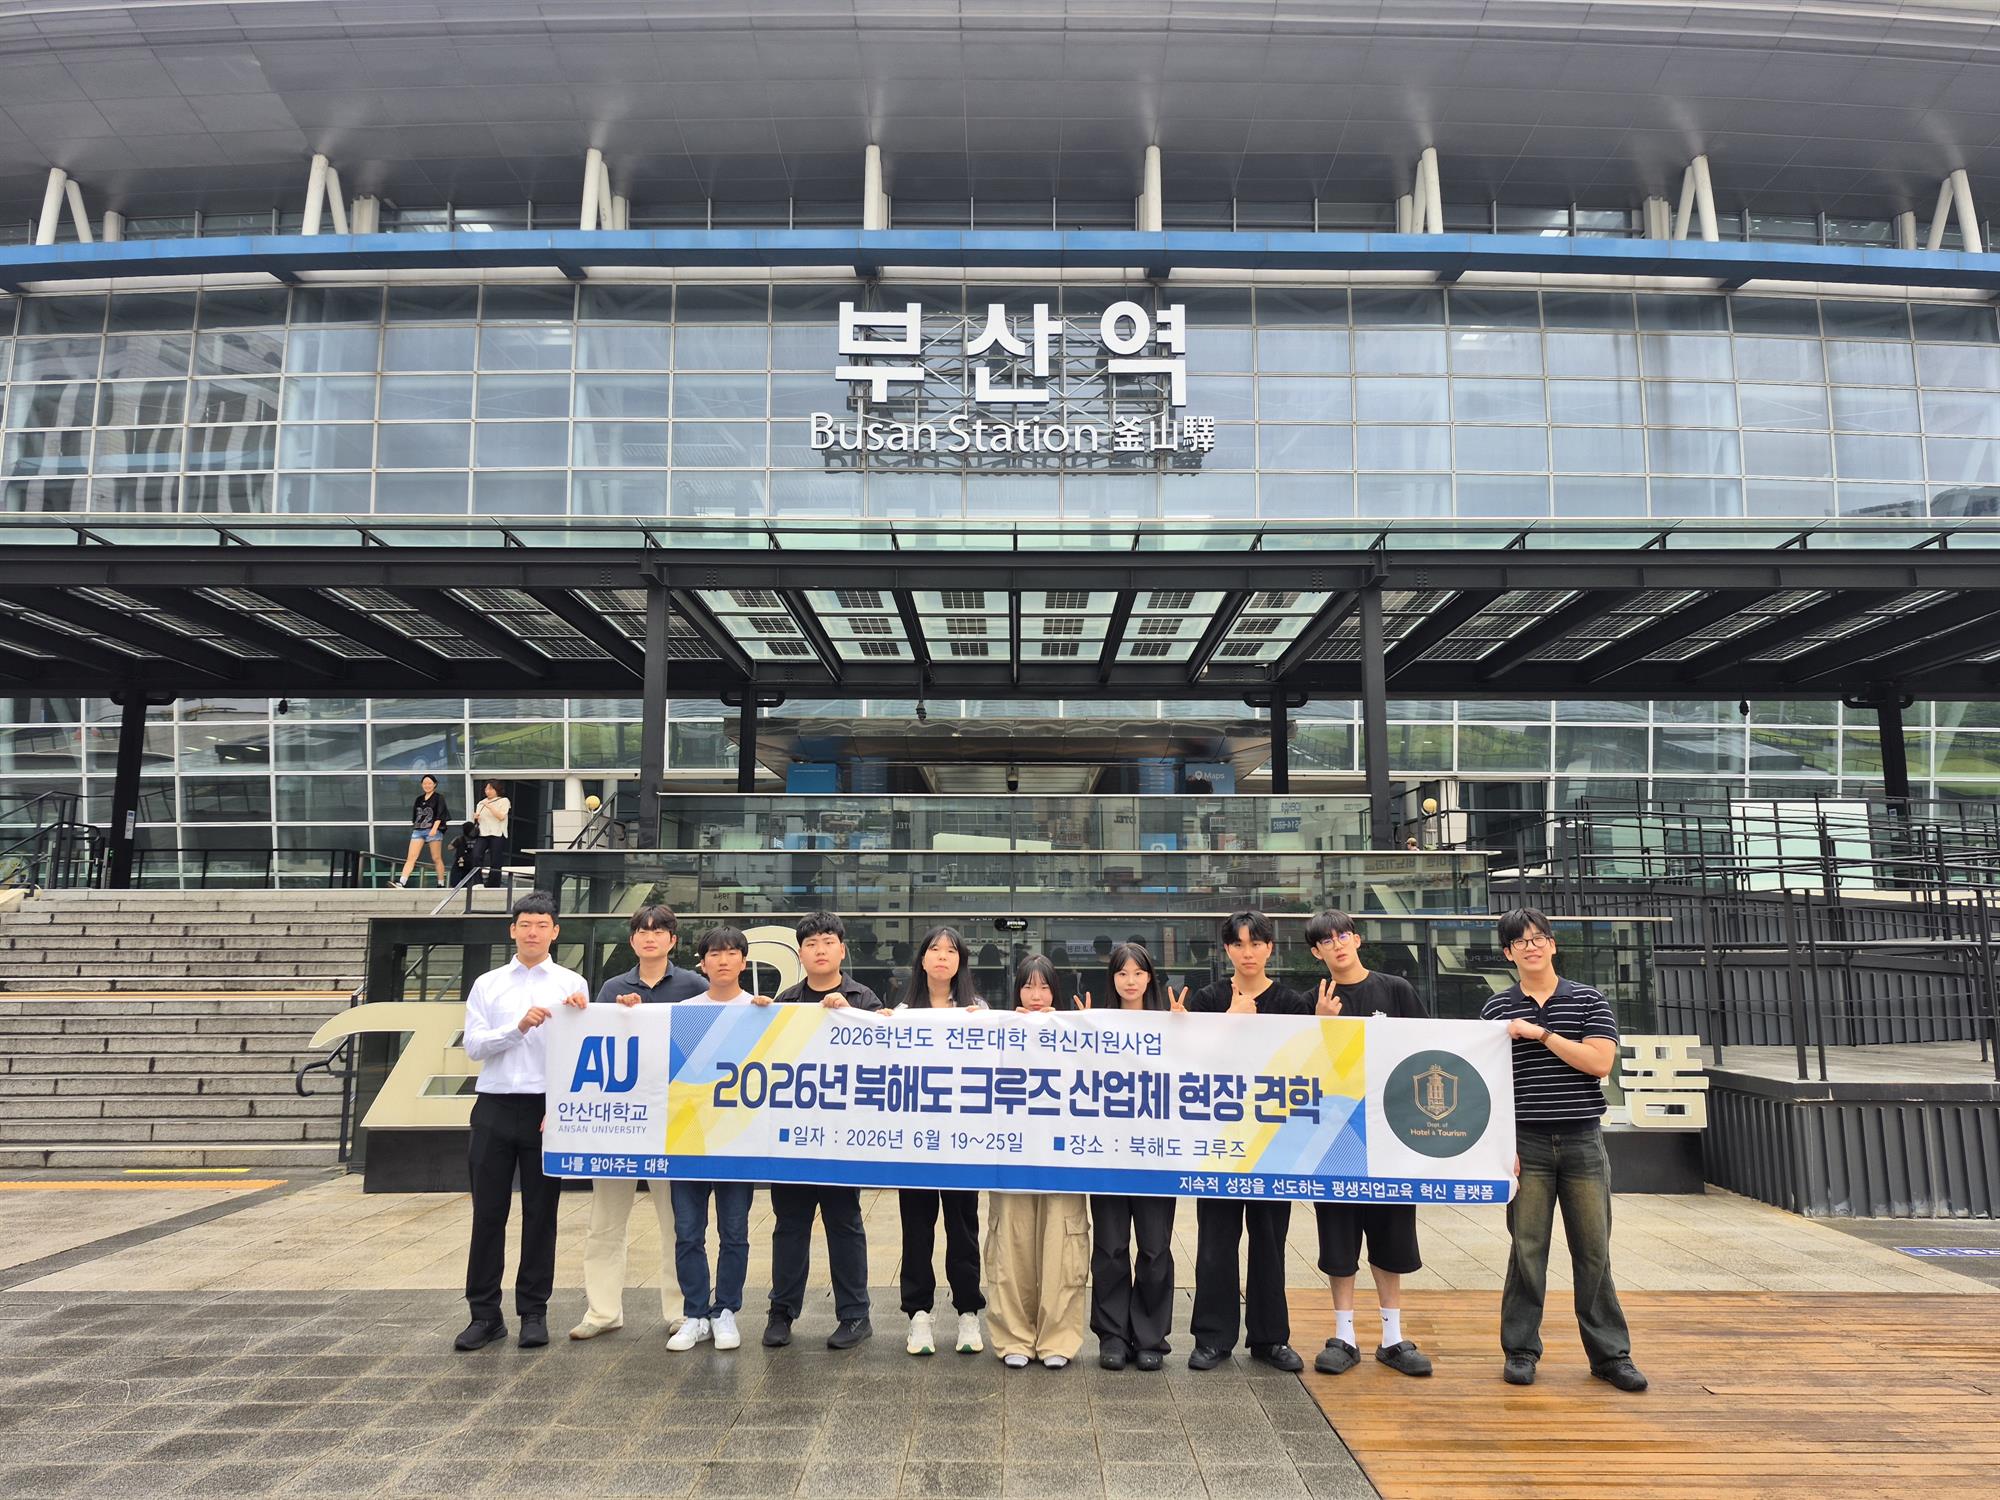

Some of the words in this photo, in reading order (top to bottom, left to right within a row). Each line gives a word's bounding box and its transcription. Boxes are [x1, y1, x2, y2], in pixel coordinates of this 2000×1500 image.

[835, 301, 1187, 406] 부산역
[810, 412, 937, 452] Busan
[948, 414, 1098, 453] Station
[1113, 415, 1215, 453] 釜山驛
[830, 1026, 935, 1049] 2026학년도
[945, 1027, 1027, 1051] 전문대학
[1038, 1029, 1162, 1056] 혁신지원사업
[570, 1036, 639, 1093] AU
[713, 1062, 848, 1110] 2026년
[854, 1064, 953, 1114] 북해도
[960, 1066, 1062, 1116] 크루즈
[1069, 1070, 1170, 1120] 산업체
[1178, 1072, 1247, 1122] 현장
[1253, 1075, 1323, 1125] 견학
[558, 1102, 648, 1123] 안산대학교
[558, 1125, 588, 1133] ANSAN
[592, 1125, 647, 1134] UNIVERSITY
[793, 1126, 825, 1146] 일자
[846, 1129, 904, 1149] 2026년
[913, 1130, 940, 1151] 6월
[951, 1132, 1023, 1153] 19~25일
[1438, 1129, 1467, 1137] Tourism
[1069, 1134, 1104, 1155] 장소
[1129, 1136, 1182, 1157] 북해도
[1194, 1138, 1247, 1159] 크루즈
[561, 1157, 584, 1172] 나를
[590, 1158, 638, 1174] 알아주는
[644, 1159, 669, 1174] 대학
[1179, 1176, 1219, 1193] 지속적
[1225, 1178, 1265, 1195] 성장을
[1272, 1180, 1325, 1197] 선도하는
[1332, 1181, 1414, 1200] 평생직업교육
[1420, 1183, 1447, 1200] 혁신
[1453, 1185, 1495, 1201] 플랫폼
